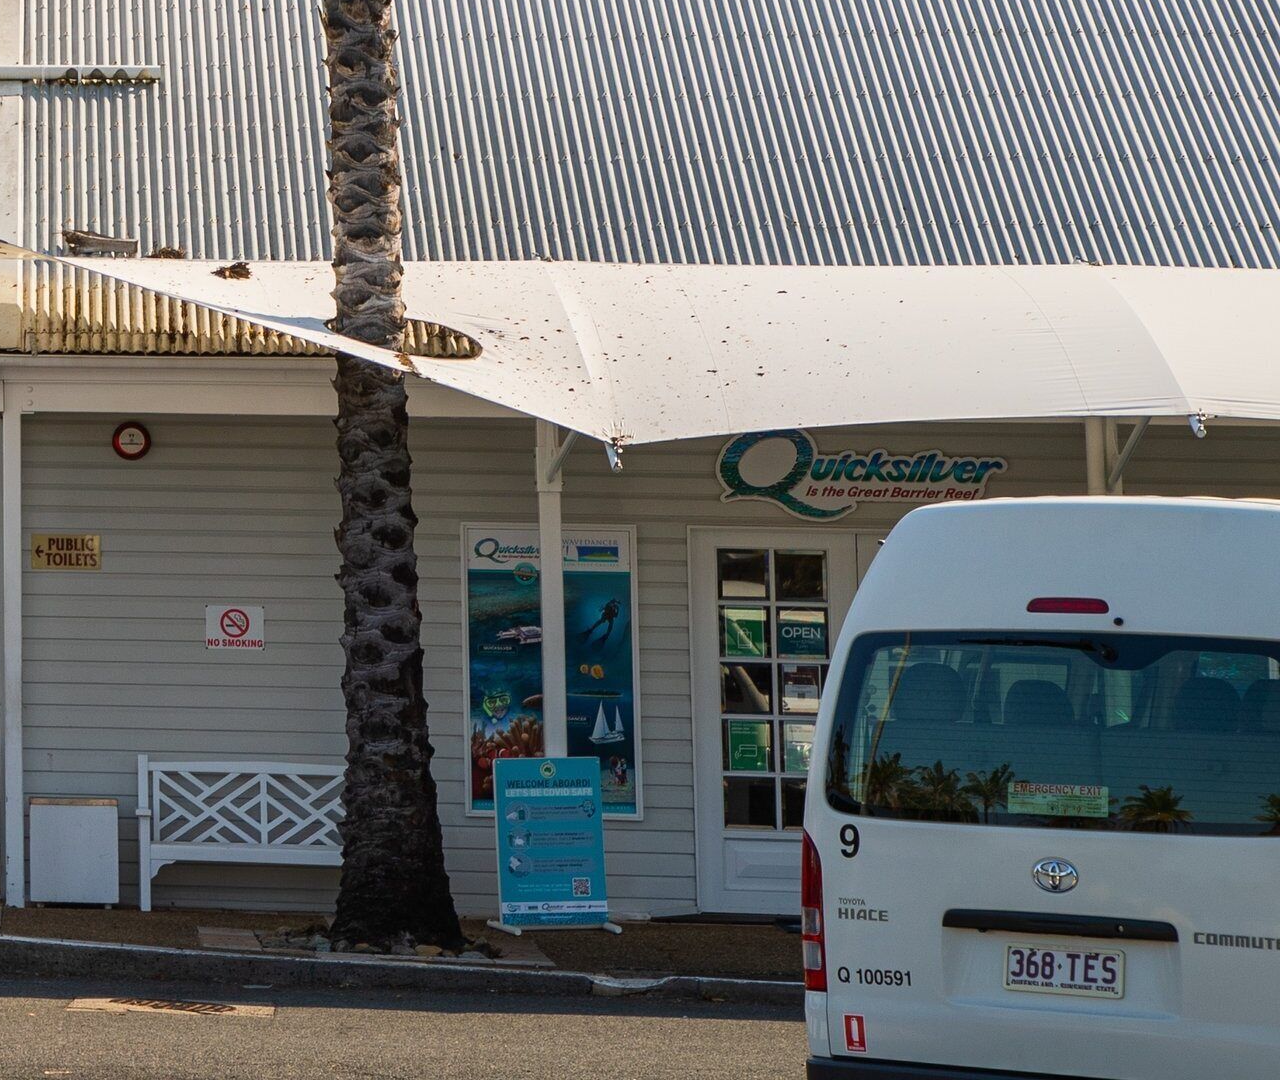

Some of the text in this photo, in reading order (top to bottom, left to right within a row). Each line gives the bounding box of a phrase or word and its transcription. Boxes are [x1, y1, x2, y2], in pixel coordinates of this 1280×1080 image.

[719, 428, 1004, 518] Quicksilver
[805, 485, 979, 500] Is the Great Barrier Reef
[48, 538, 95, 552] PUBLIC
[44, 553, 97, 567] TOILETS
[781, 626, 820, 639] OPEN
[207, 638, 263, 648] NO SMOKING
[506, 779, 550, 789] WELCOME
[1013, 782, 1103, 796] EMERGENCY EXIT
[840, 823, 860, 858] 9
[838, 897, 866, 906] TOYOTA
[838, 908, 889, 922] HIACE
[837, 966, 912, 987] Q 100591
